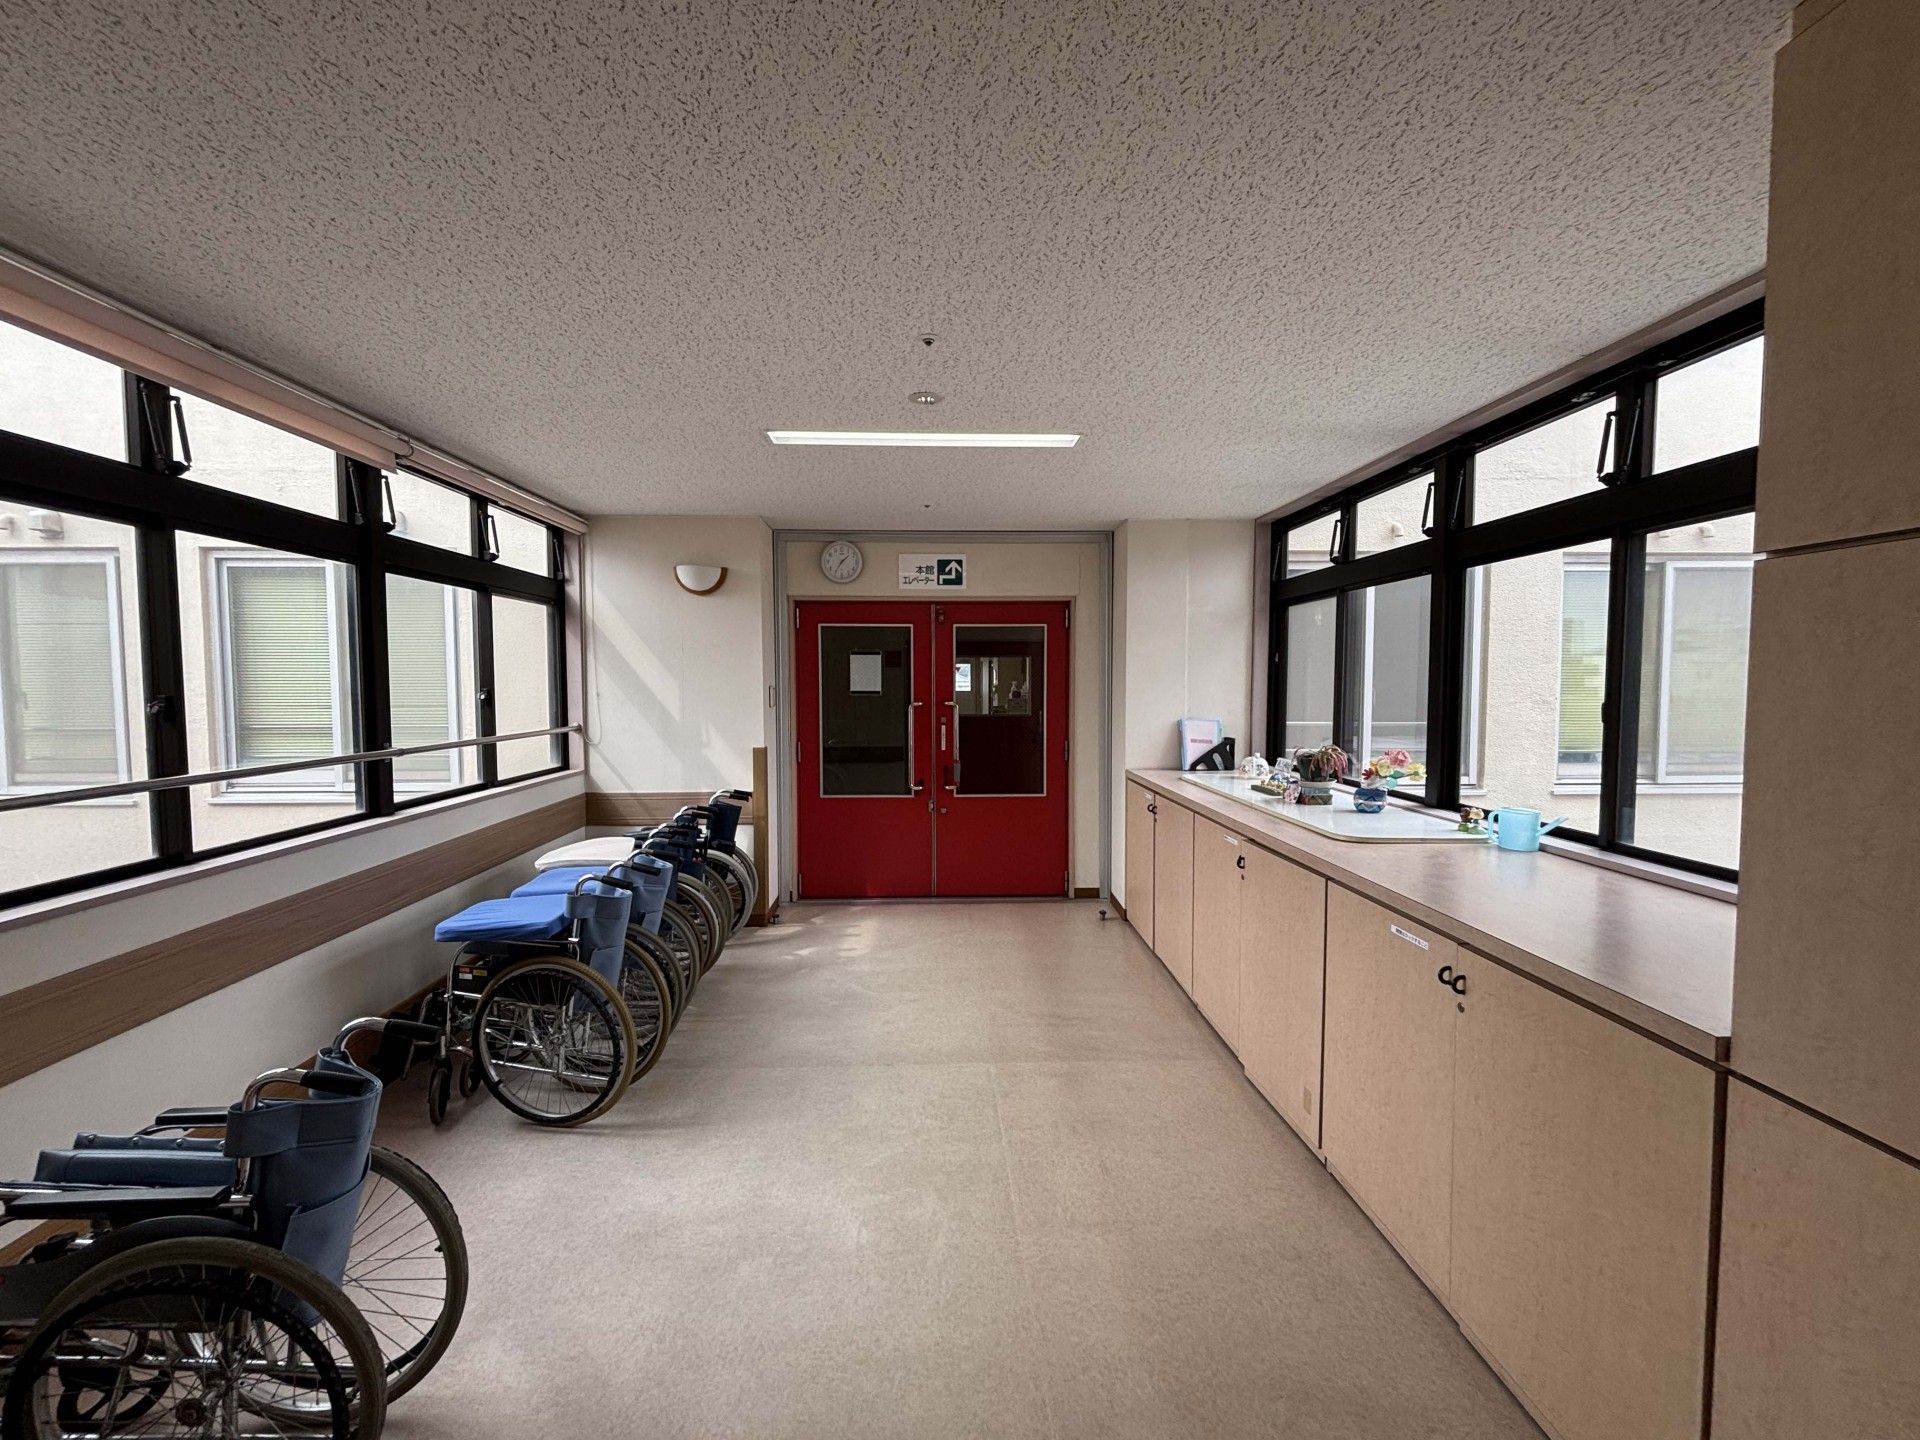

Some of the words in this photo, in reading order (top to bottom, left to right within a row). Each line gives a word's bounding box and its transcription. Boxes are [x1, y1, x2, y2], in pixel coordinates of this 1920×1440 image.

[916, 566, 935, 575] 本館
[902, 576, 935, 584] エレベーター
